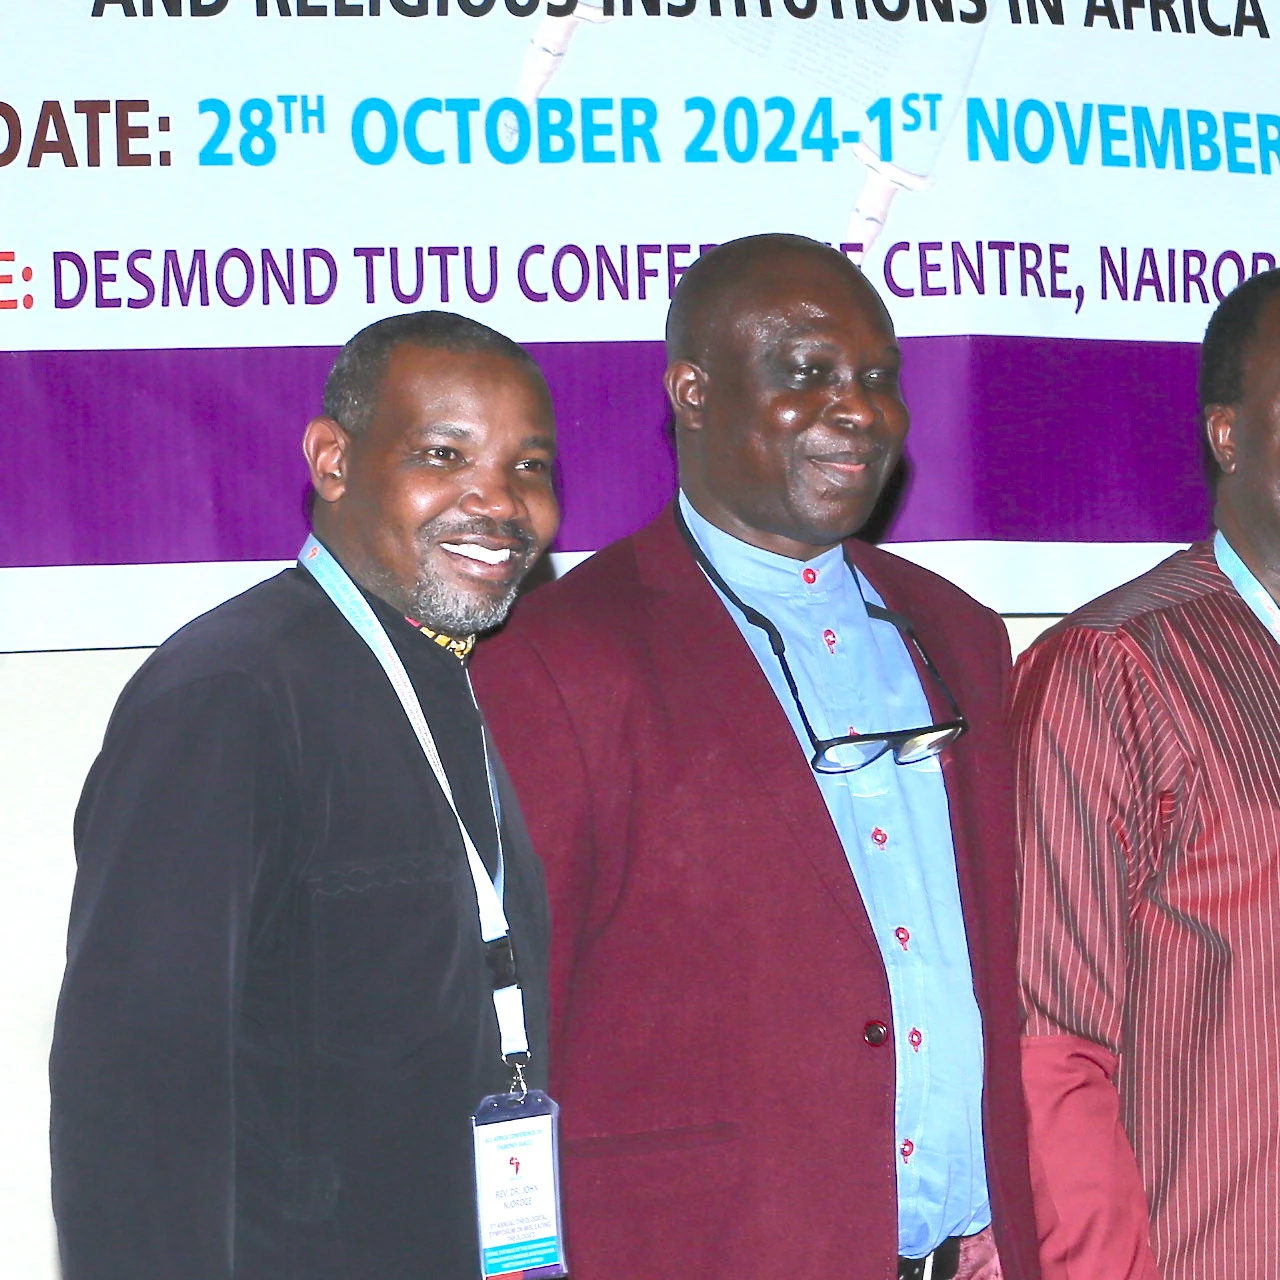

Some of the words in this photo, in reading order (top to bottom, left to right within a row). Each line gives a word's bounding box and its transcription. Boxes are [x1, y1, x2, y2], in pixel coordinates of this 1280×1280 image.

[351, 97, 661, 165] OCTOBER
[53, 248, 337, 309] DESMOND
[354, 246, 497, 304] TUTU
[884, 241, 1084, 313] CENTRE,
